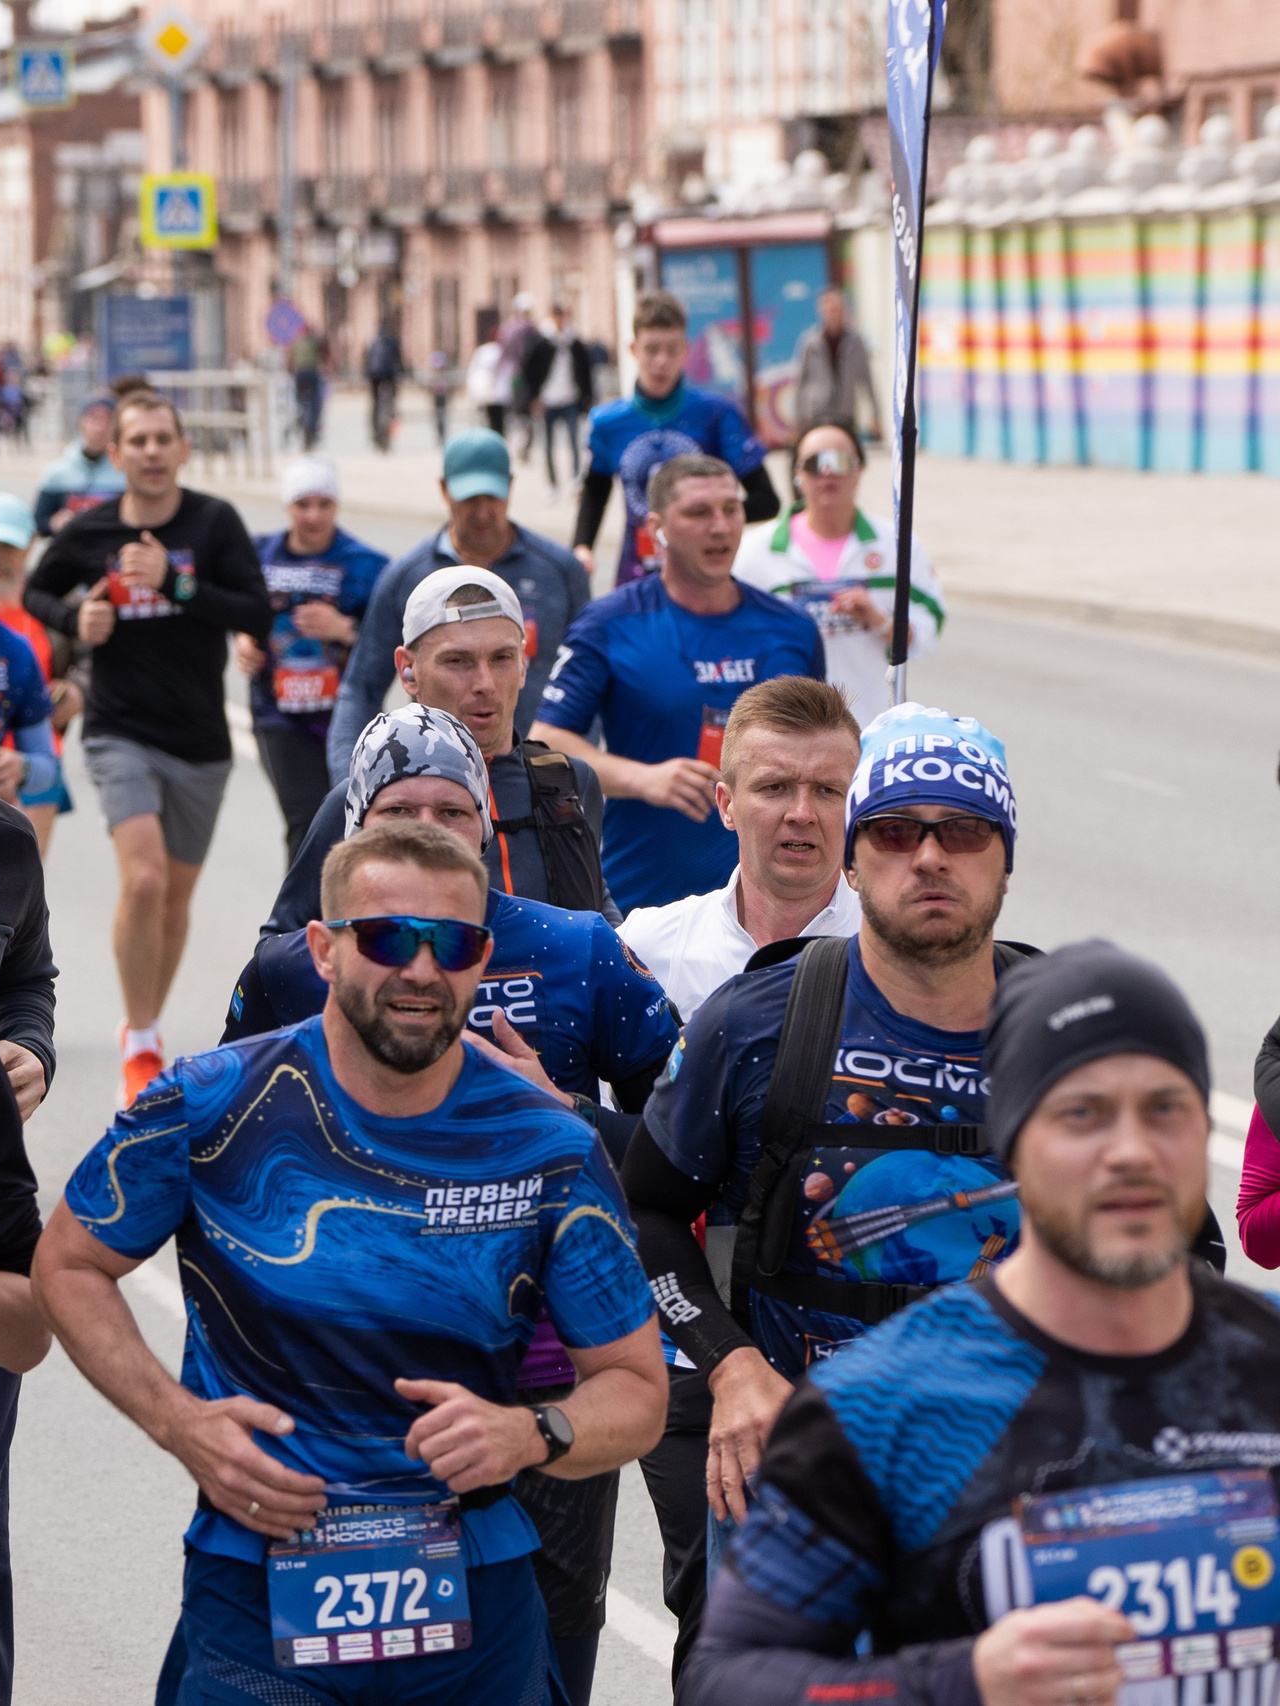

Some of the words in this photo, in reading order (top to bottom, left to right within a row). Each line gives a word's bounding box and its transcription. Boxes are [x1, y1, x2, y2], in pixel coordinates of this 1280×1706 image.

[424, 1173, 544, 1207] ПЕРВЫЙ
[423, 1199, 532, 1226] ТРЕНЕР
[420, 1226, 453, 1236] ШКОЛА
[454, 1224, 477, 1235] БЕГА
[478, 1224, 486, 1233] И
[487, 1218, 539, 1232] ТРИАТЛОНА
[659, 1291, 703, 1326] cep
[325, 1523, 337, 1533] Я
[338, 1517, 406, 1532] ПРОСТО
[325, 1526, 407, 1544] КОСМОС
[314, 1567, 431, 1629] 2372
[437, 1578, 454, 1598] D
[1087, 1553, 1240, 1636] 2314
